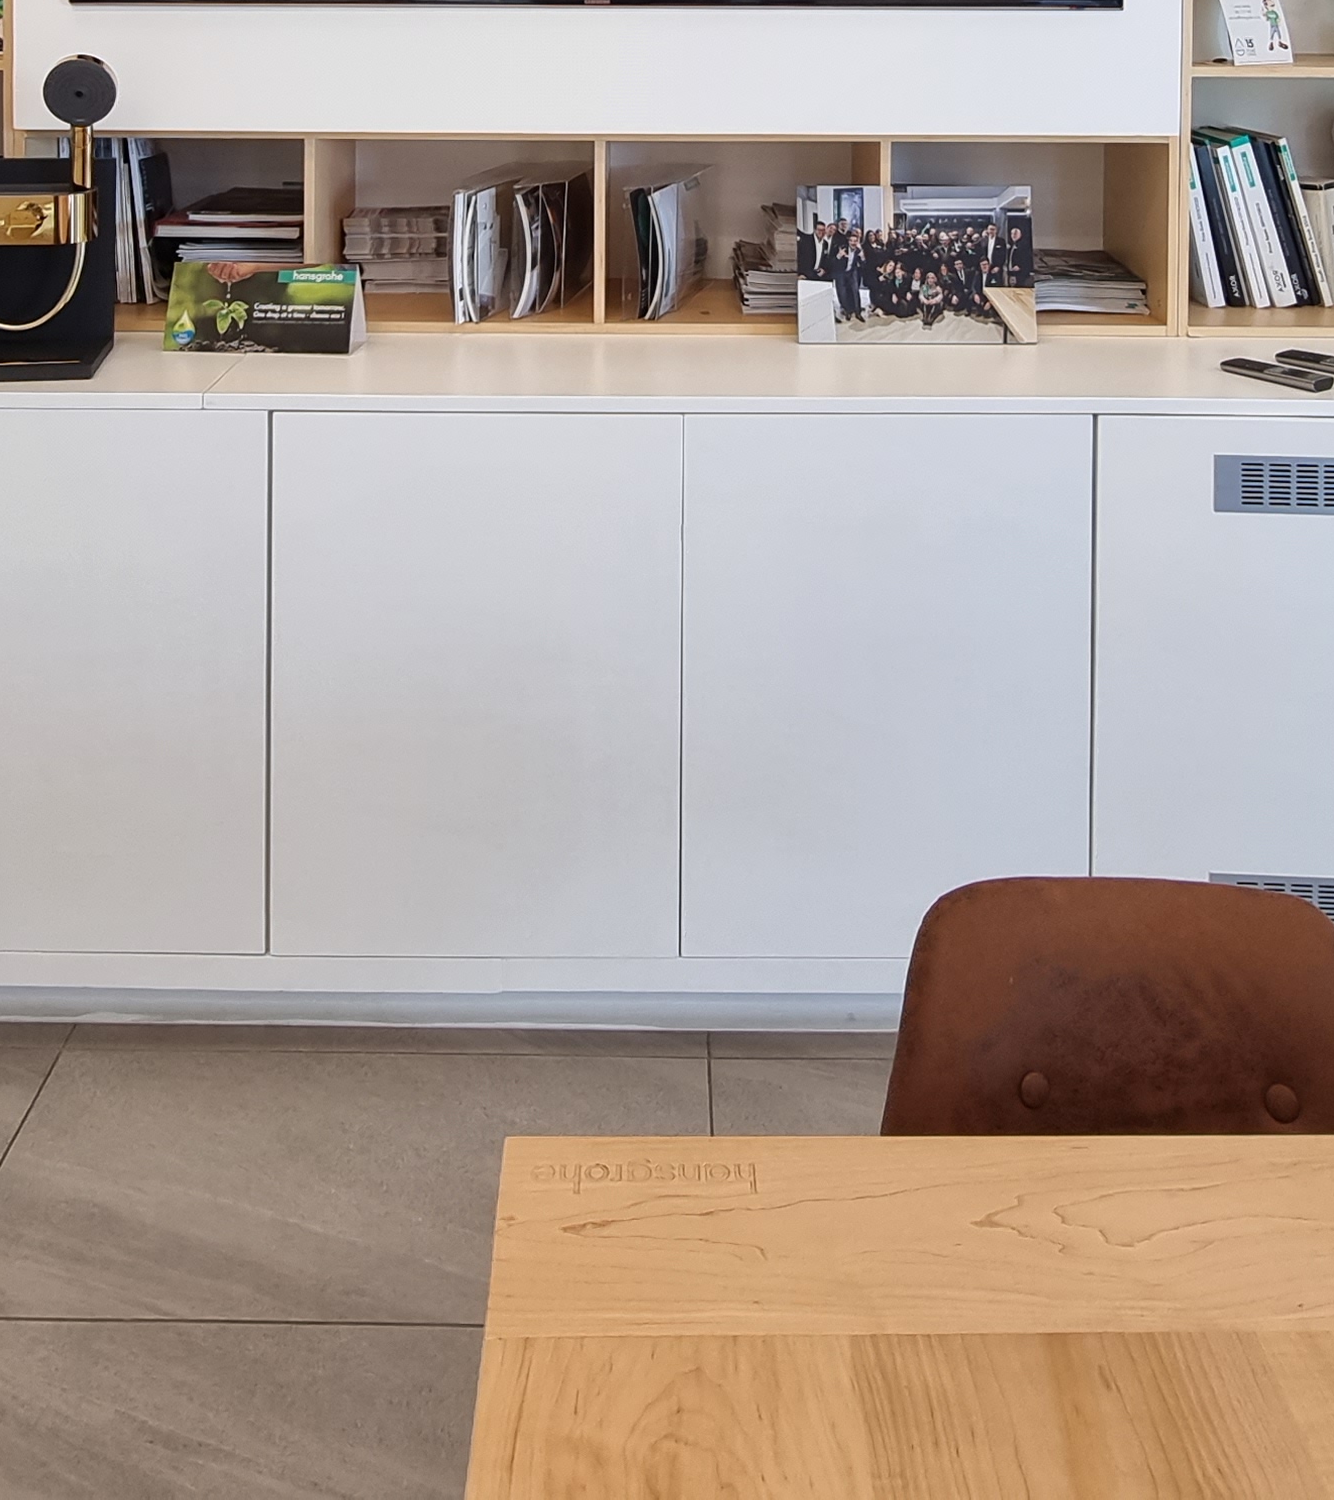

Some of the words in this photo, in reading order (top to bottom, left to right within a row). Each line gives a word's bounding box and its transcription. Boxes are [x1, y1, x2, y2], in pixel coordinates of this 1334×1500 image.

[293, 270, 344, 282] hansgrohe
[1229, 274, 1241, 299] AXOR
[1271, 269, 1285, 293] AXOR
[530, 1158, 759, 1195] hansgrohe
